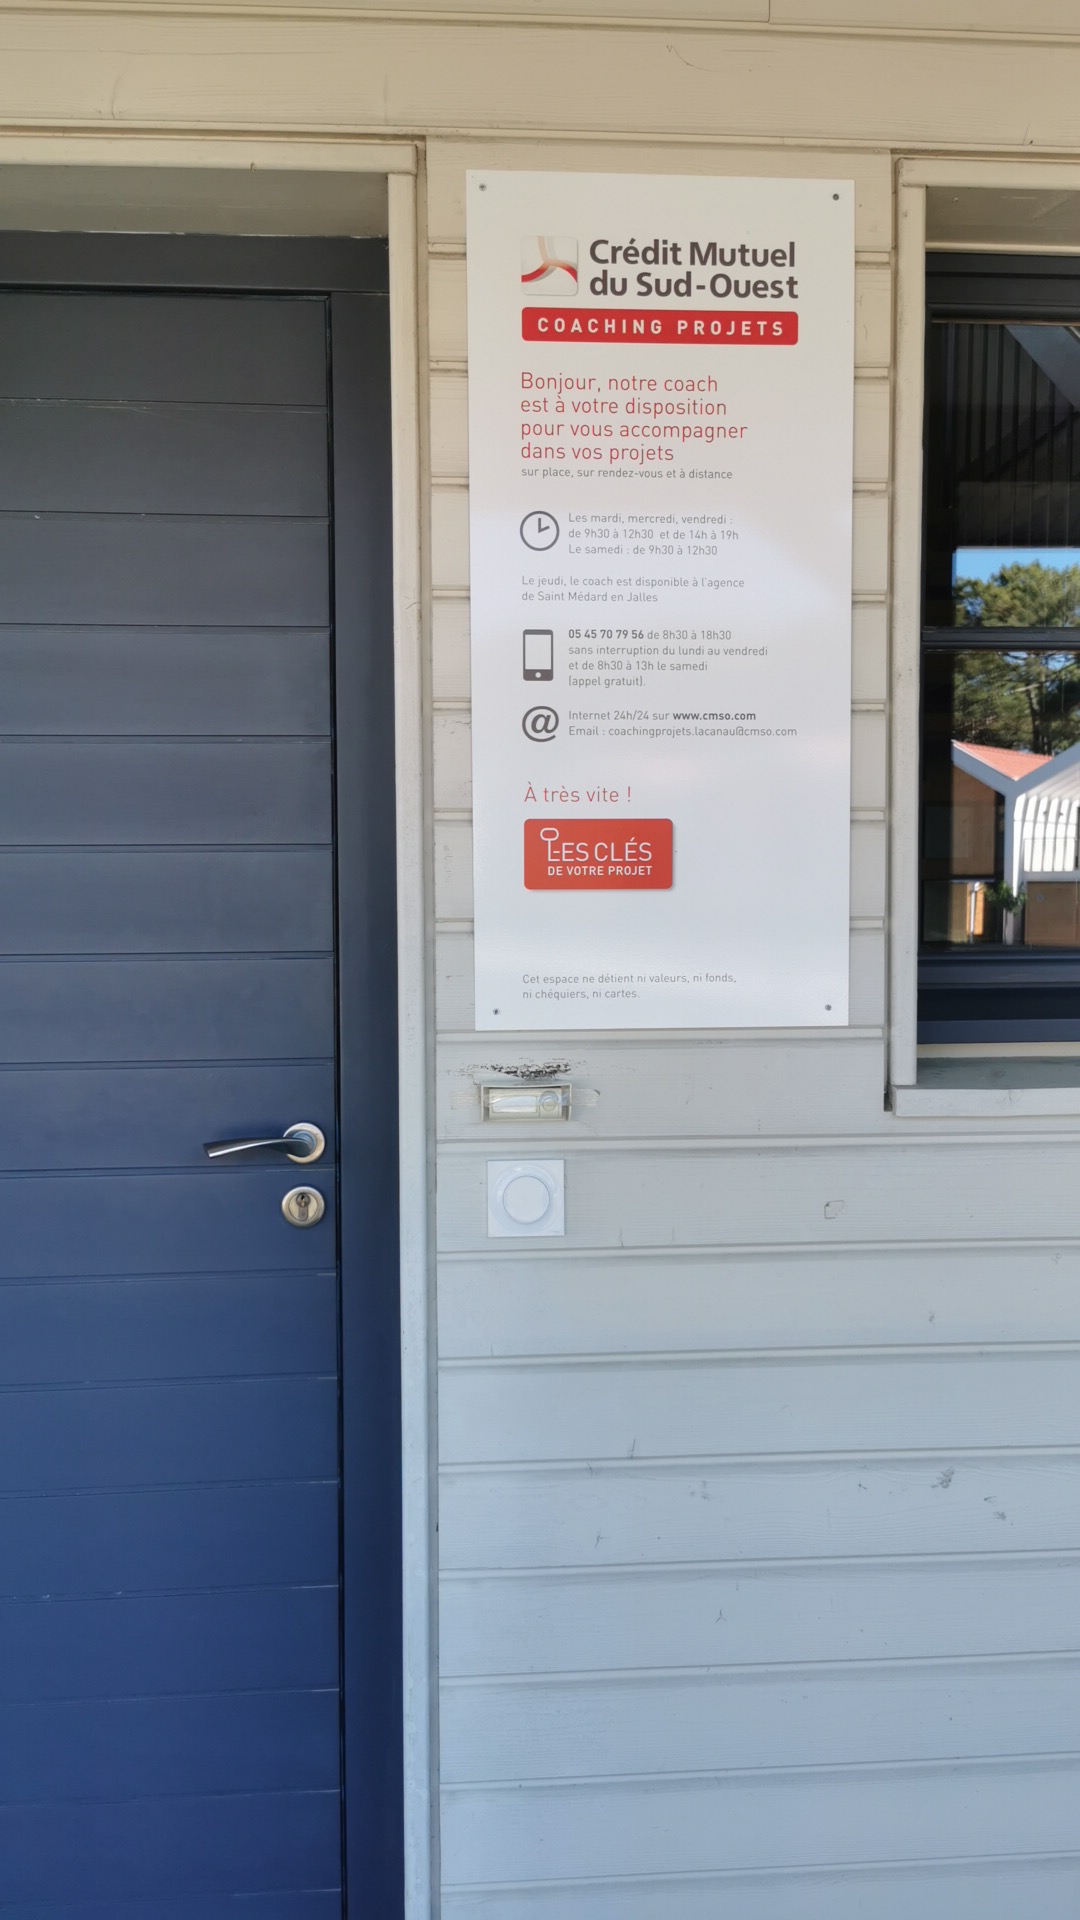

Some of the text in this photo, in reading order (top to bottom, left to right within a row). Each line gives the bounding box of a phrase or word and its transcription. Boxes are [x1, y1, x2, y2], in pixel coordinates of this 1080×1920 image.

[589, 238, 795, 267] Crédit Mutuel
[590, 270, 798, 299] du Sud-Ouest
[538, 317, 784, 336] COACHING PROJETS
[521, 372, 718, 394] Bonjour, notre coach
[521, 396, 727, 419] est à votre disposition
[521, 422, 748, 442] pour vous accompagner
[521, 443, 674, 465] dans vos projets
[521, 467, 732, 479] sur place, sur rendez-vous et à distance
[568, 514, 588, 523] Les
[591, 513, 624, 524] mardi,
[628, 514, 678, 525] mercredi,
[682, 514, 727, 524] vendredi
[568, 528, 738, 540] de 9h30 à 12h30 et de 14h à 19h
[569, 544, 582, 554] Le
[585, 544, 623, 554] samedi
[633, 545, 646, 555] de
[649, 545, 673, 555] 9h30
[677, 545, 683, 555] à
[686, 545, 718, 555] 12h30
[522, 576, 535, 586] Le
[538, 576, 566, 588] jeudi,
[570, 576, 580, 586] le
[583, 577, 613, 586] coach
[616, 577, 632, 587] est
[635, 577, 689, 589] disponible
[692, 577, 698, 587] à
[522, 591, 658, 602] de Saint Médard en Jalles
[568, 629, 731, 640] 05 45 70 79 56 de 8h30 à 18h30
[568, 647, 593, 655] sans
[596, 645, 659, 657] interruption
[662, 645, 675, 655] du
[679, 645, 704, 655] lundi
[723, 646, 768, 656] vendredi
[568, 660, 708, 671] et de 8h30 à 13h le samedi
[569, 711, 756, 721] Internet 24h/24 sur www.cmso.com
[569, 726, 599, 736] Email
[608, 726, 797, 739] coachingprojets.lacanau@cmso.com
[524, 781, 537, 802] À
[543, 786, 580, 802] très
[586, 786, 619, 802] vite
[594, 837, 652, 862] CLÉS
[548, 865, 652, 875] DE VOTRE PROJET
[523, 974, 540, 984] Cet
[543, 976, 579, 986] espace
[598, 973, 634, 984] détient
[637, 974, 646, 983] ni
[649, 973, 690, 984] valeurs,
[693, 973, 702, 982] ni
[705, 973, 736, 983] fonds,
[523, 988, 640, 1000] ni chéquiers, ni cartes.
